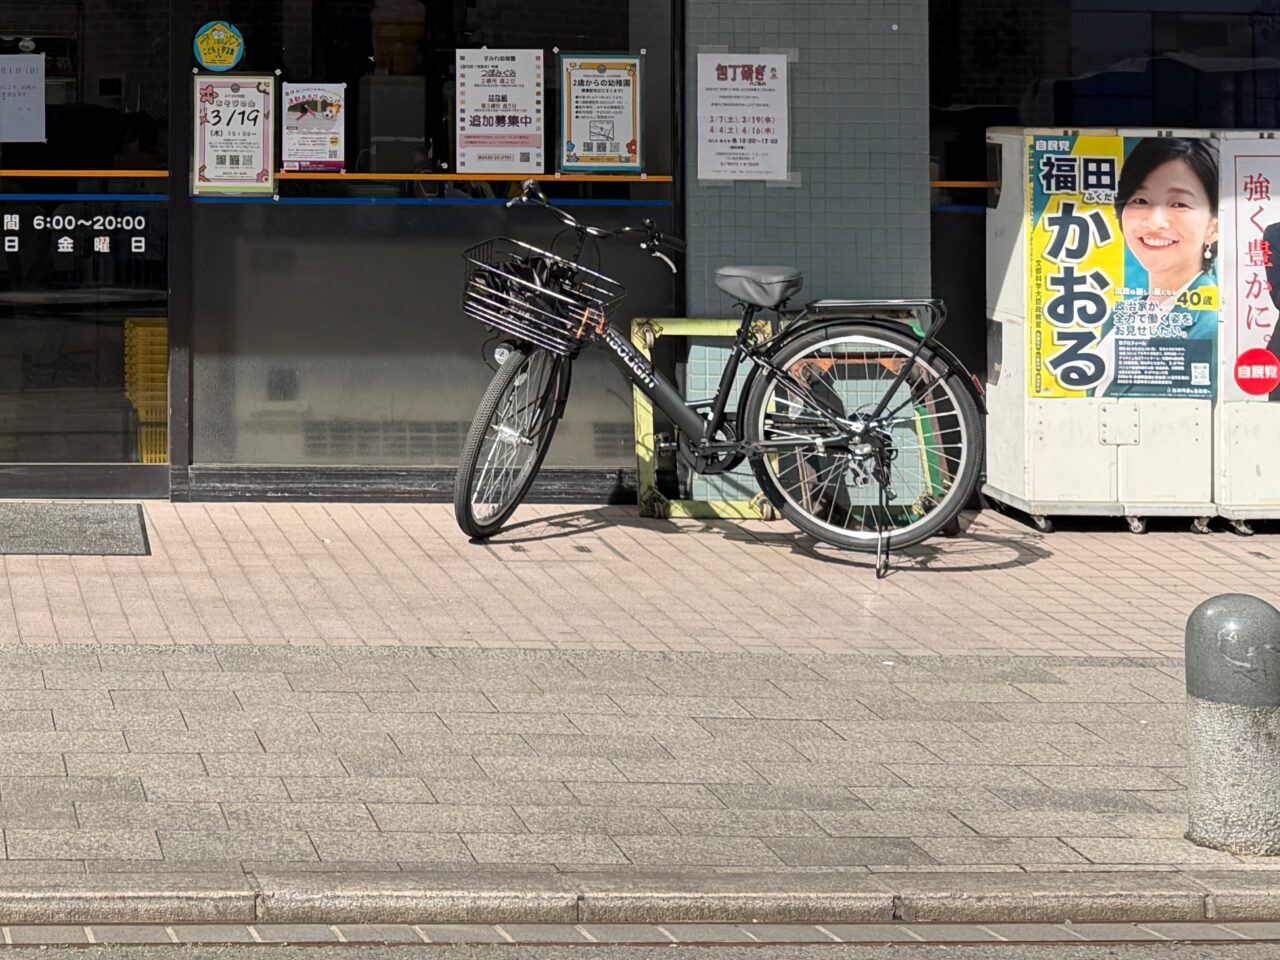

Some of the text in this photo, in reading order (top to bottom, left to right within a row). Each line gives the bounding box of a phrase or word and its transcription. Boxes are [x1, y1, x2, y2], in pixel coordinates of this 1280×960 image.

[210, 109, 261, 127] 3/19
[469, 115, 533, 128] 追加募集中
[1036, 141, 1070, 151] 自民党
[1040, 155, 1117, 193] 福田
[1085, 192, 1114, 202] ふくだ
[1243, 172, 1273, 344] 強く豊かに。
[1046, 202, 1112, 388] かおる
[1176, 291, 1213, 306] 40歳
[1114, 301, 1164, 312] 政治家が、
[1114, 313, 1192, 324] 全力で働く姿を
[1114, 325, 1187, 337] お見せしたい。
[1237, 365, 1279, 380] 自民党
